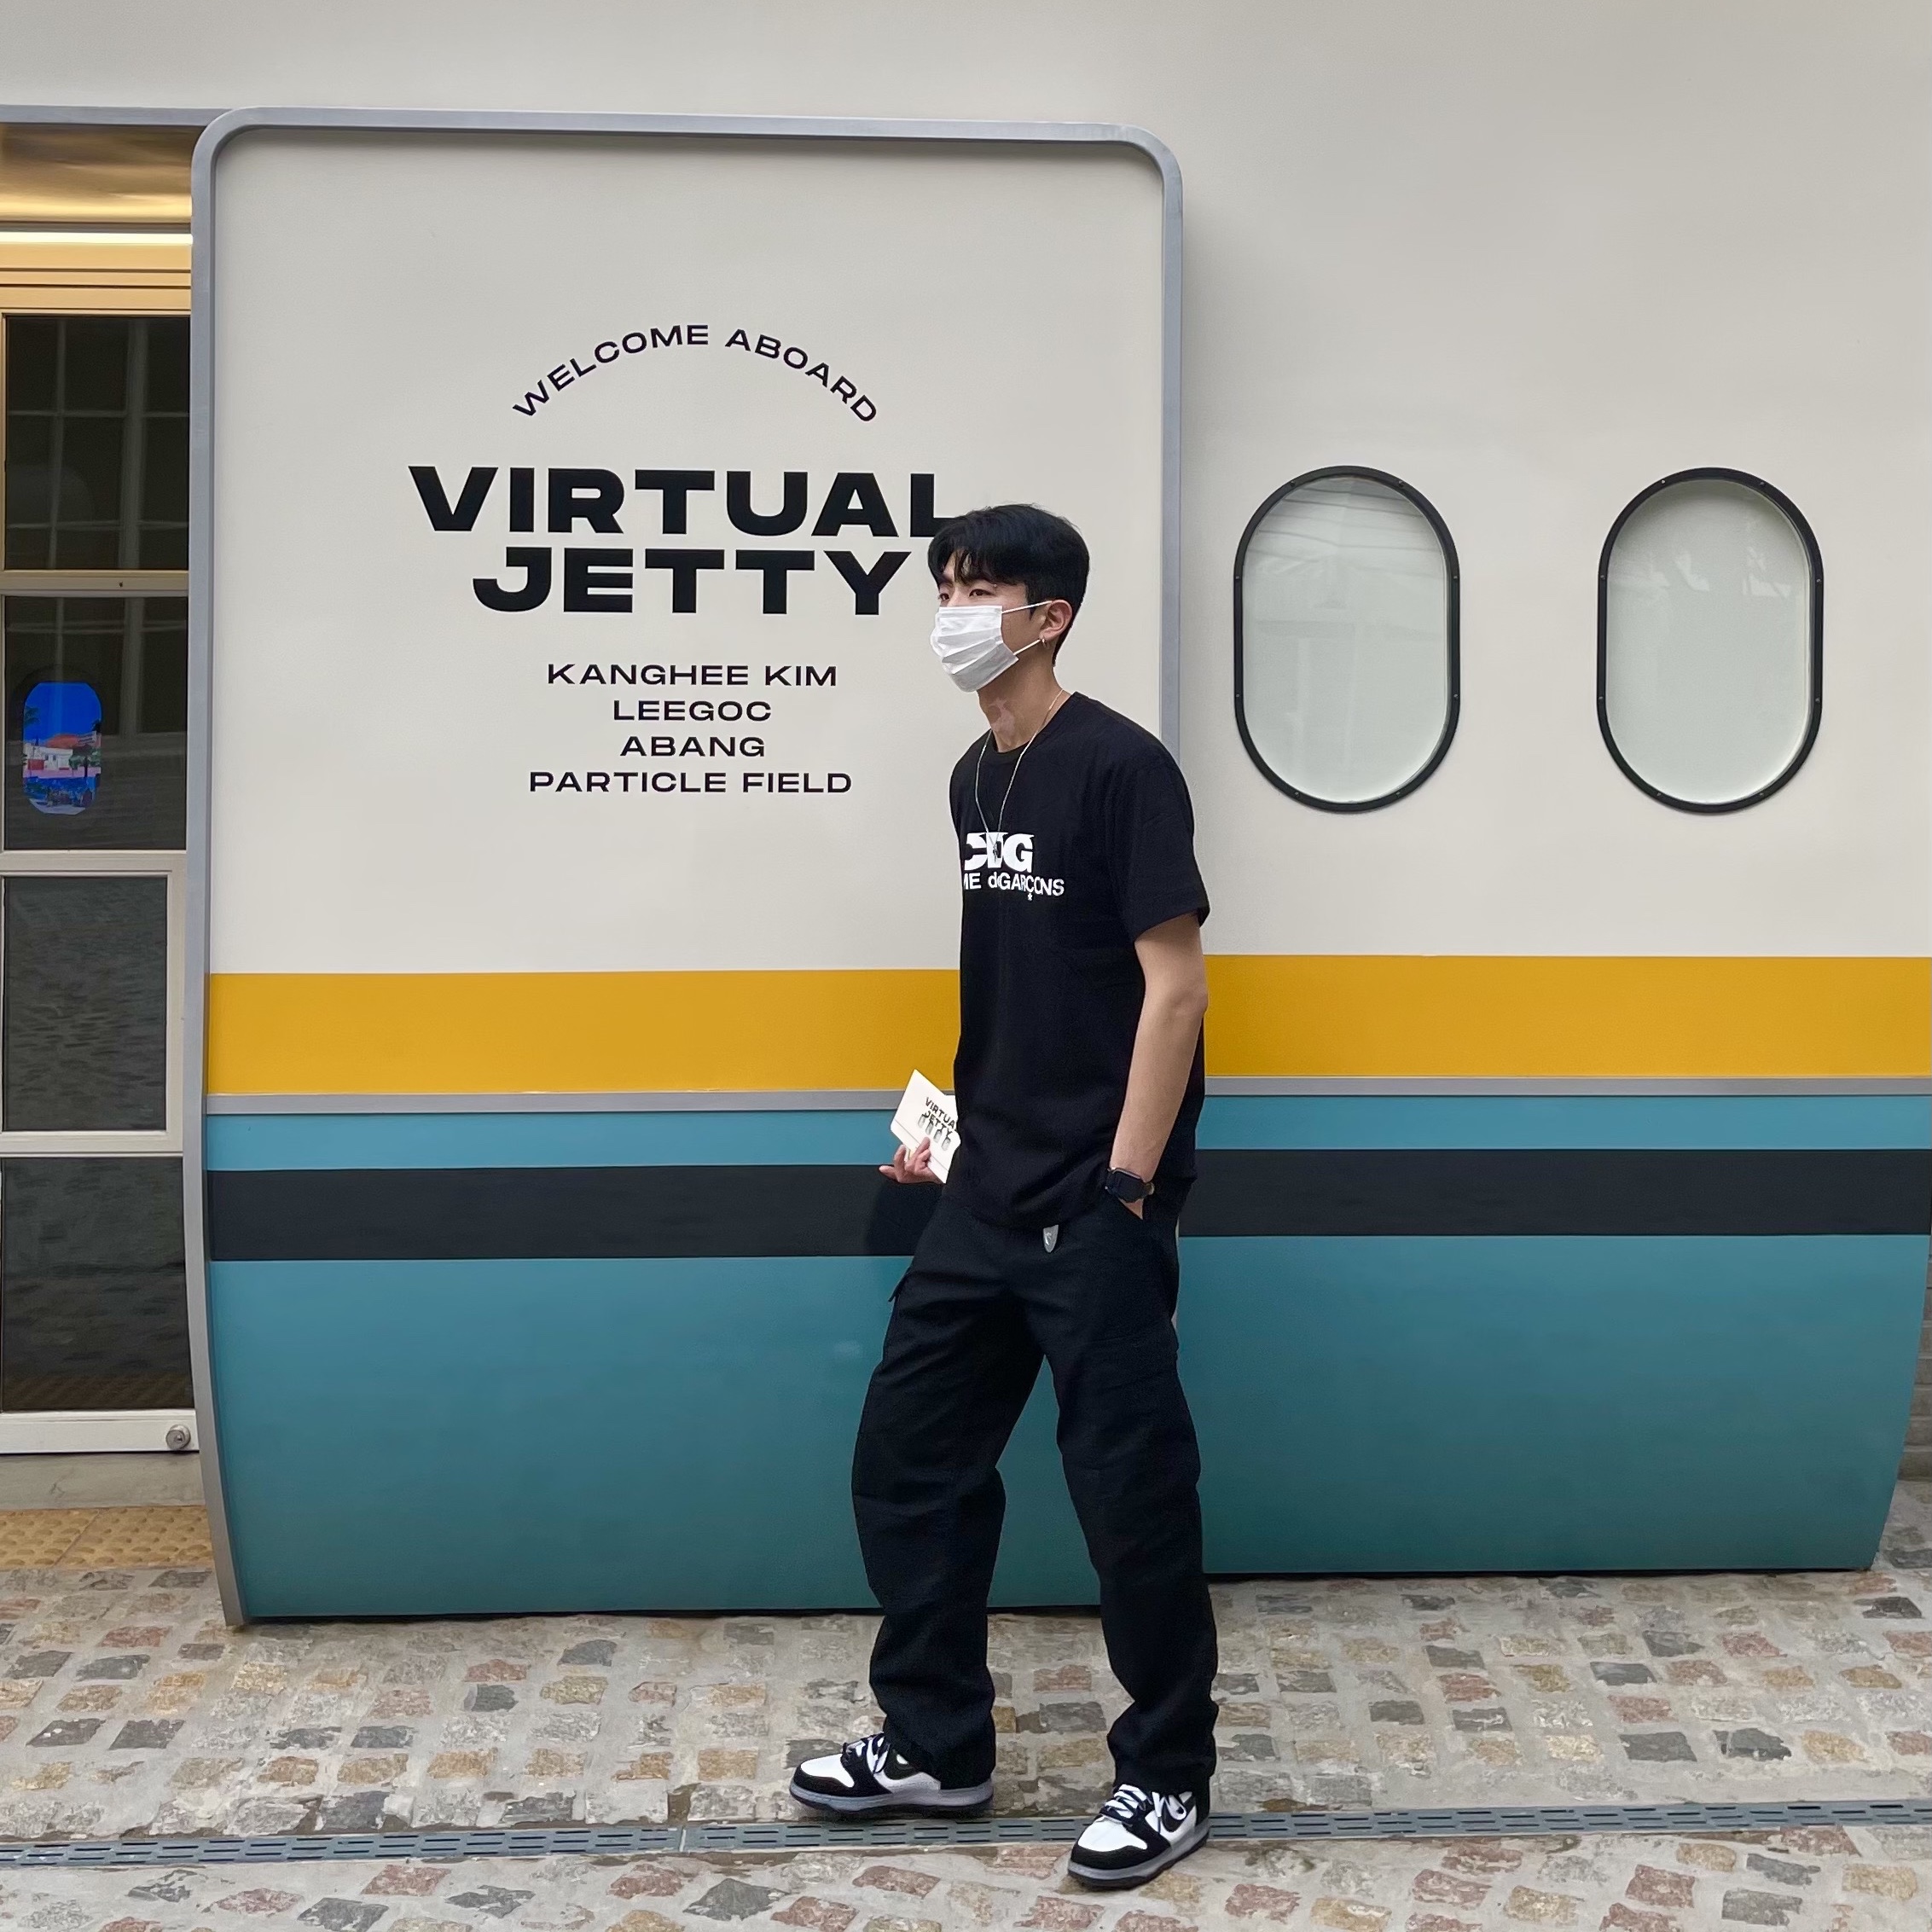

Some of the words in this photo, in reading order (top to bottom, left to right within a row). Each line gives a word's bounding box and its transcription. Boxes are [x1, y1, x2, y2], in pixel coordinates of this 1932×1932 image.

[512, 324, 709, 416] WELCOME
[724, 328, 877, 422] ABOARD
[408, 465, 962, 537] VIRTUAL
[473, 546, 912, 616] JETTY
[548, 664, 749, 686] KANGHEE
[765, 665, 837, 687] KIM
[613, 699, 771, 722] LEEGOC
[619, 736, 764, 757] ABANG
[530, 771, 727, 793] PARTICLE
[743, 772, 851, 793] FIELD
[925, 1097, 957, 1132] VIRTUA
